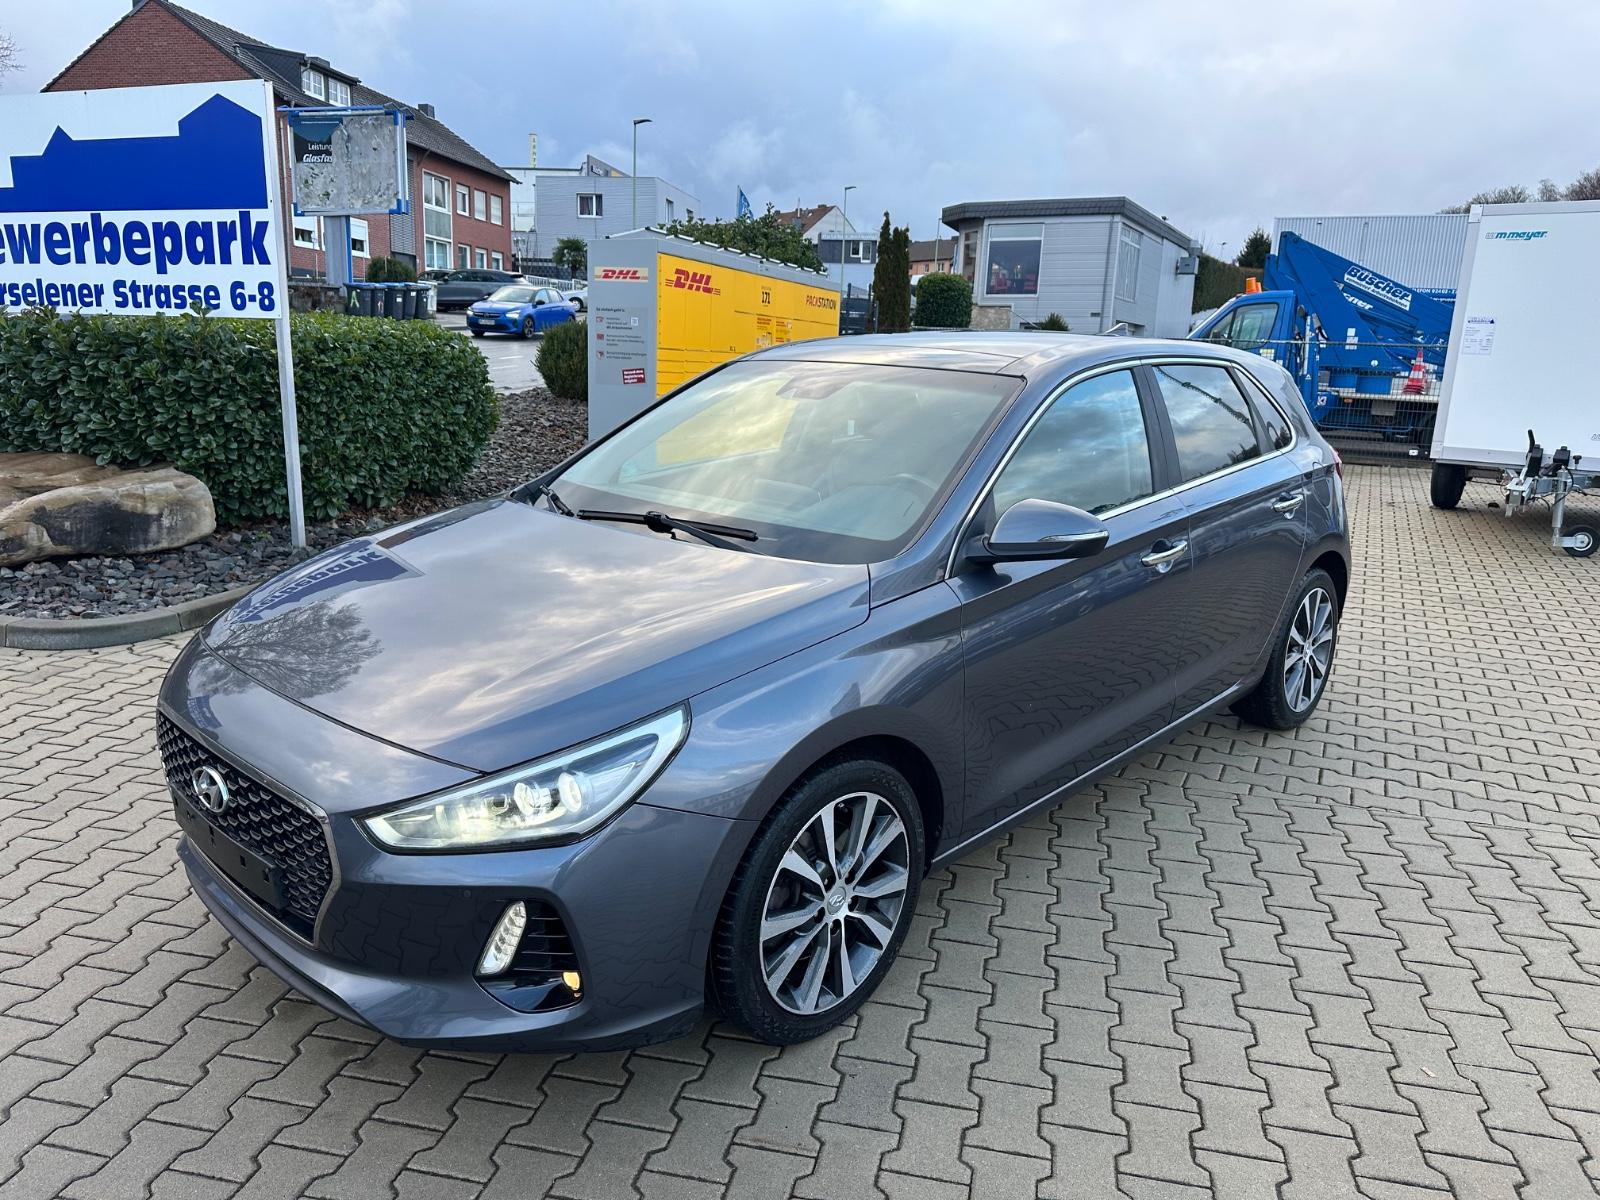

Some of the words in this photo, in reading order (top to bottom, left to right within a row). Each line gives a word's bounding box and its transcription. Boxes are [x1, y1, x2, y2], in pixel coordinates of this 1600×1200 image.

[0, 211, 271, 275] werbepark
[602, 269, 640, 279] DHL
[674, 268, 714, 294] DHL
[113, 279, 220, 310] Strasse
[230, 280, 275, 312] 6-8
[762, 291, 770, 304] 171
[806, 294, 836, 310] PACKSTATION
